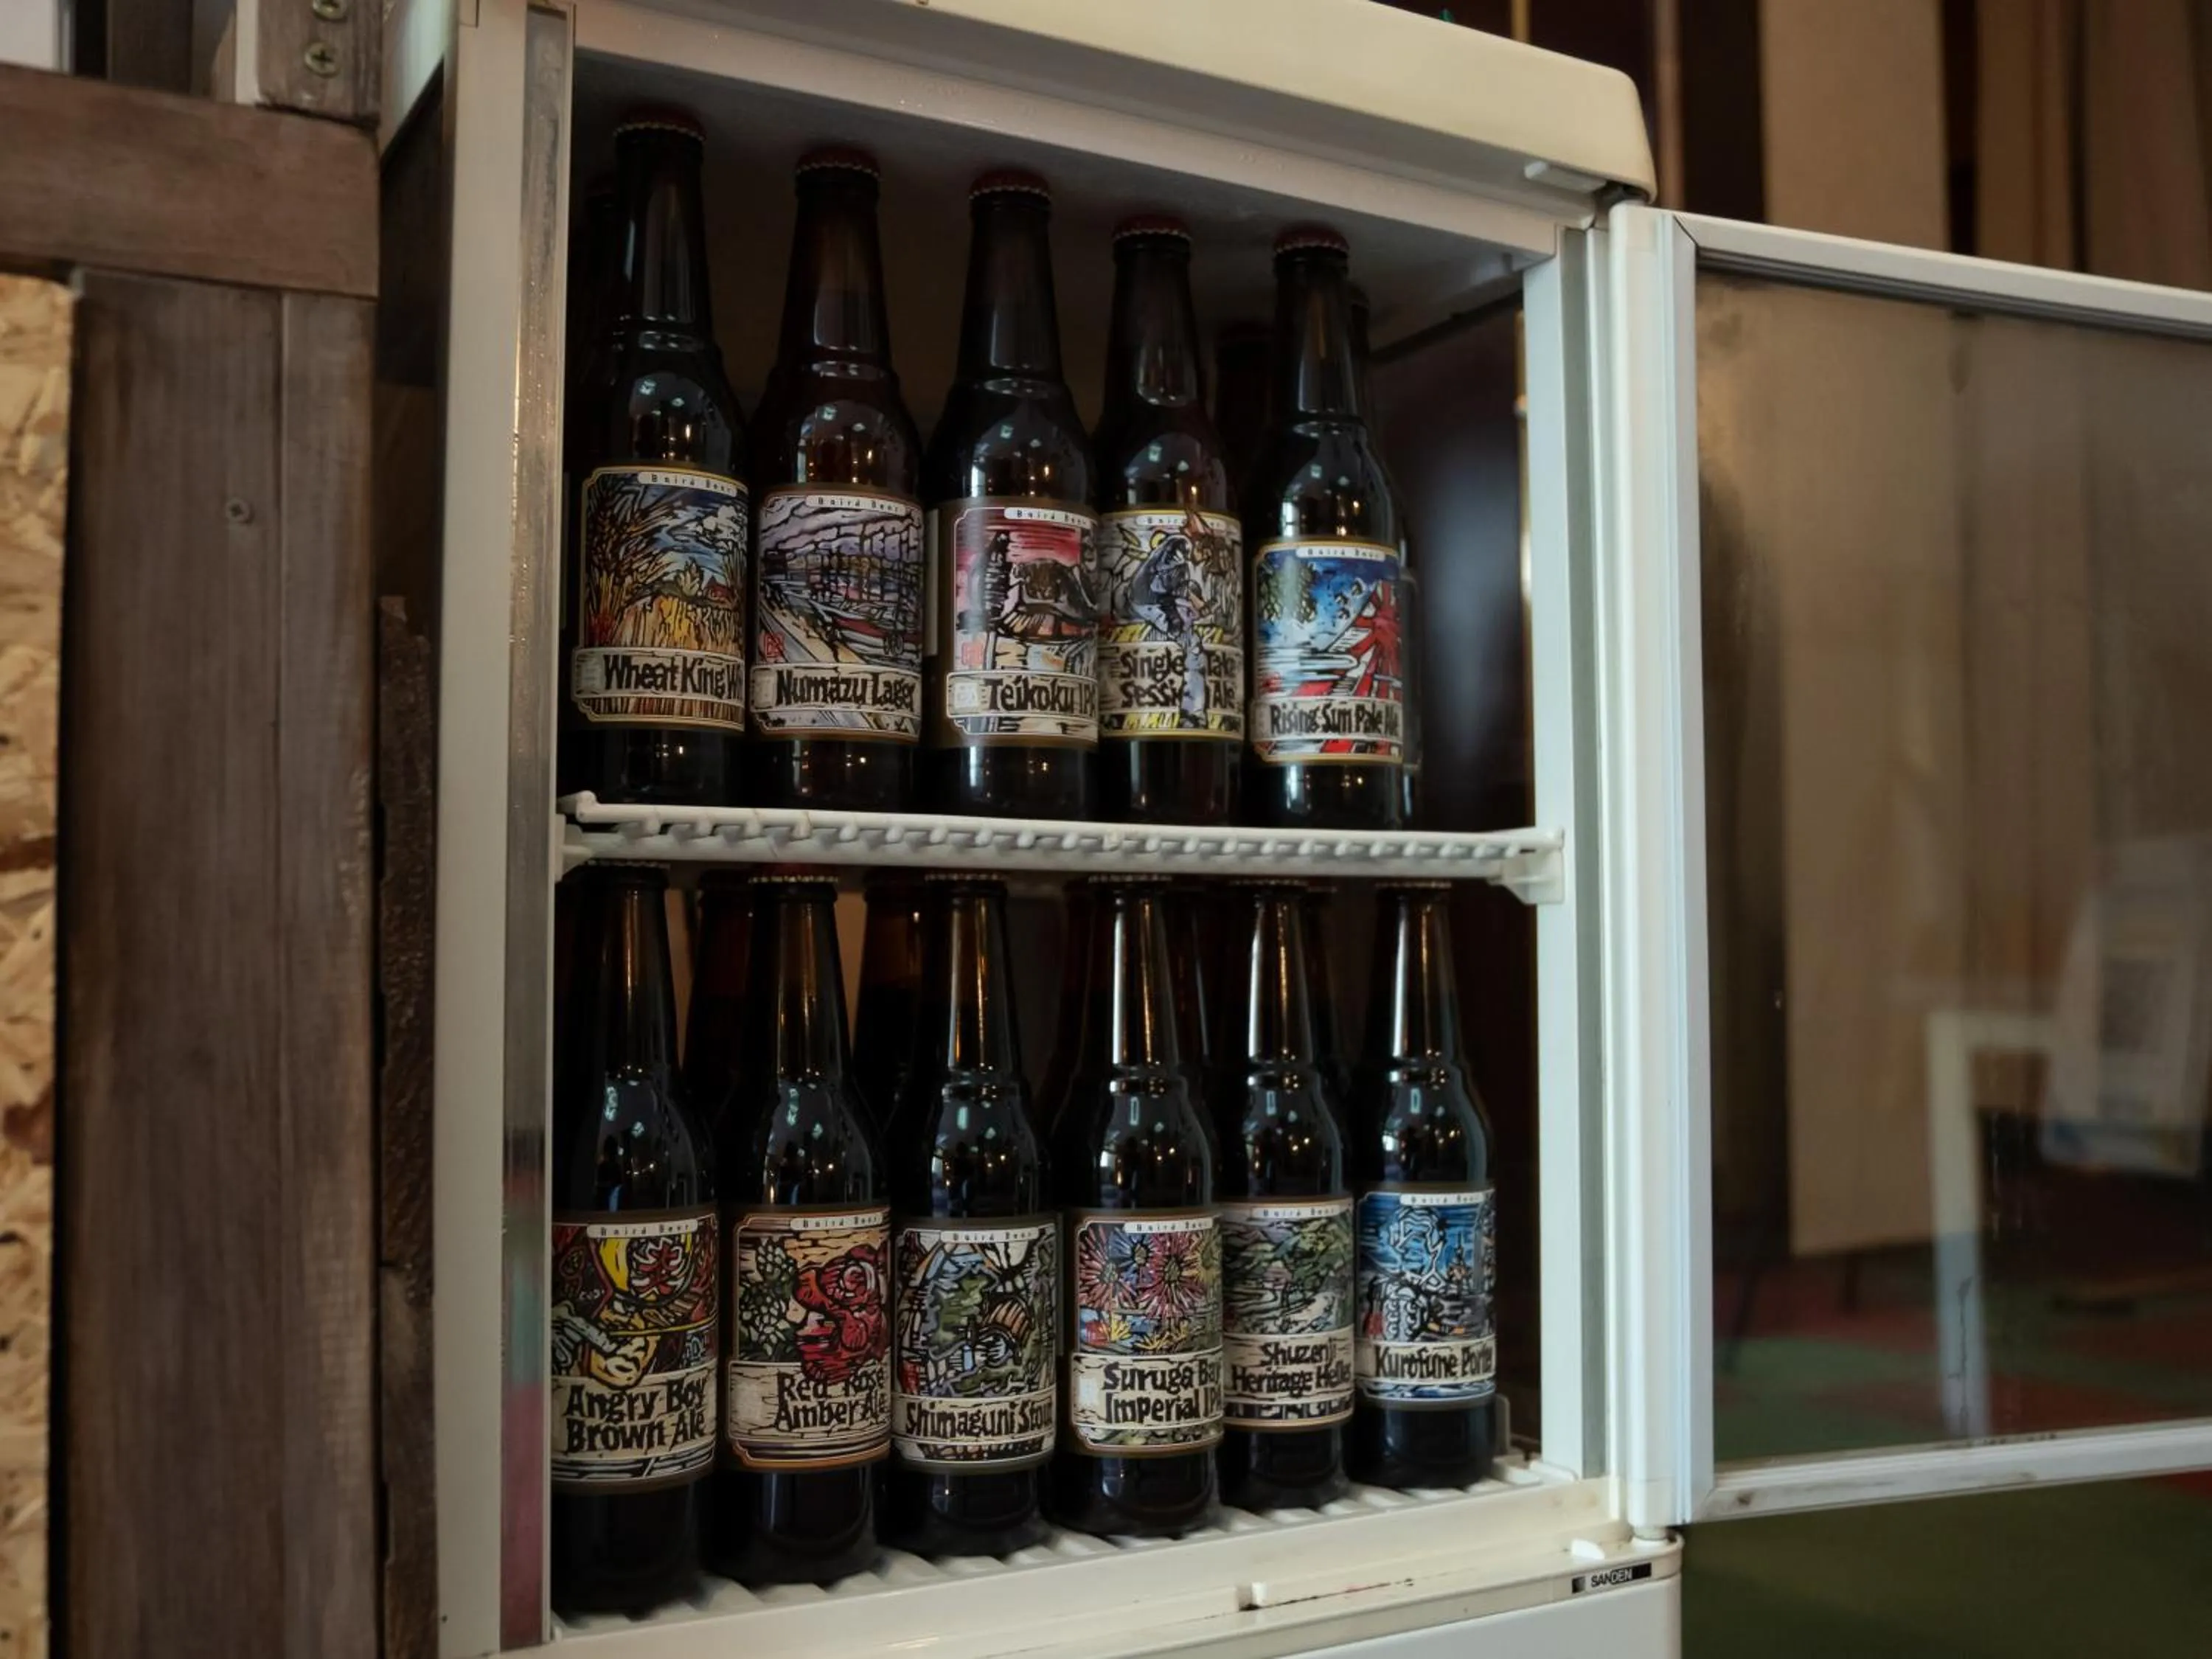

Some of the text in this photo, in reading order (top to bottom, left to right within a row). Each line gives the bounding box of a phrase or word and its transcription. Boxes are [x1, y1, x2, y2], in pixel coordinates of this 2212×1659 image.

[651, 473, 732, 493] Baird Beer
[818, 496, 899, 512] Baird Beer
[1016, 509, 1056, 521] Baird
[603, 654, 678, 692] Wheat
[681, 654, 725, 700] King
[1120, 647, 1183, 682] Single
[871, 672, 915, 712] Lager
[985, 675, 1074, 713] Teikoku
[1269, 701, 1321, 735] Rising
[1322, 702, 1353, 734] Sun
[1354, 702, 1382, 734] Pale
[601, 1224, 689, 1237] Baird Beer
[803, 1217, 845, 1228] Baird
[952, 1232, 995, 1242] Baird
[1259, 1338, 1337, 1366] Shuzenji
[1374, 1344, 1458, 1380] Kurofune
[777, 1369, 830, 1402] Red
[1102, 1361, 1195, 1394] Suruga
[1231, 1364, 1313, 1398] Heritage
[566, 1375, 708, 1424] Angry Boy
[775, 1398, 866, 1431] Amber
[1105, 1388, 1201, 1424] Imperial
[566, 1408, 705, 1453] Brown Ale
[905, 1401, 1016, 1439] Shimaguni
